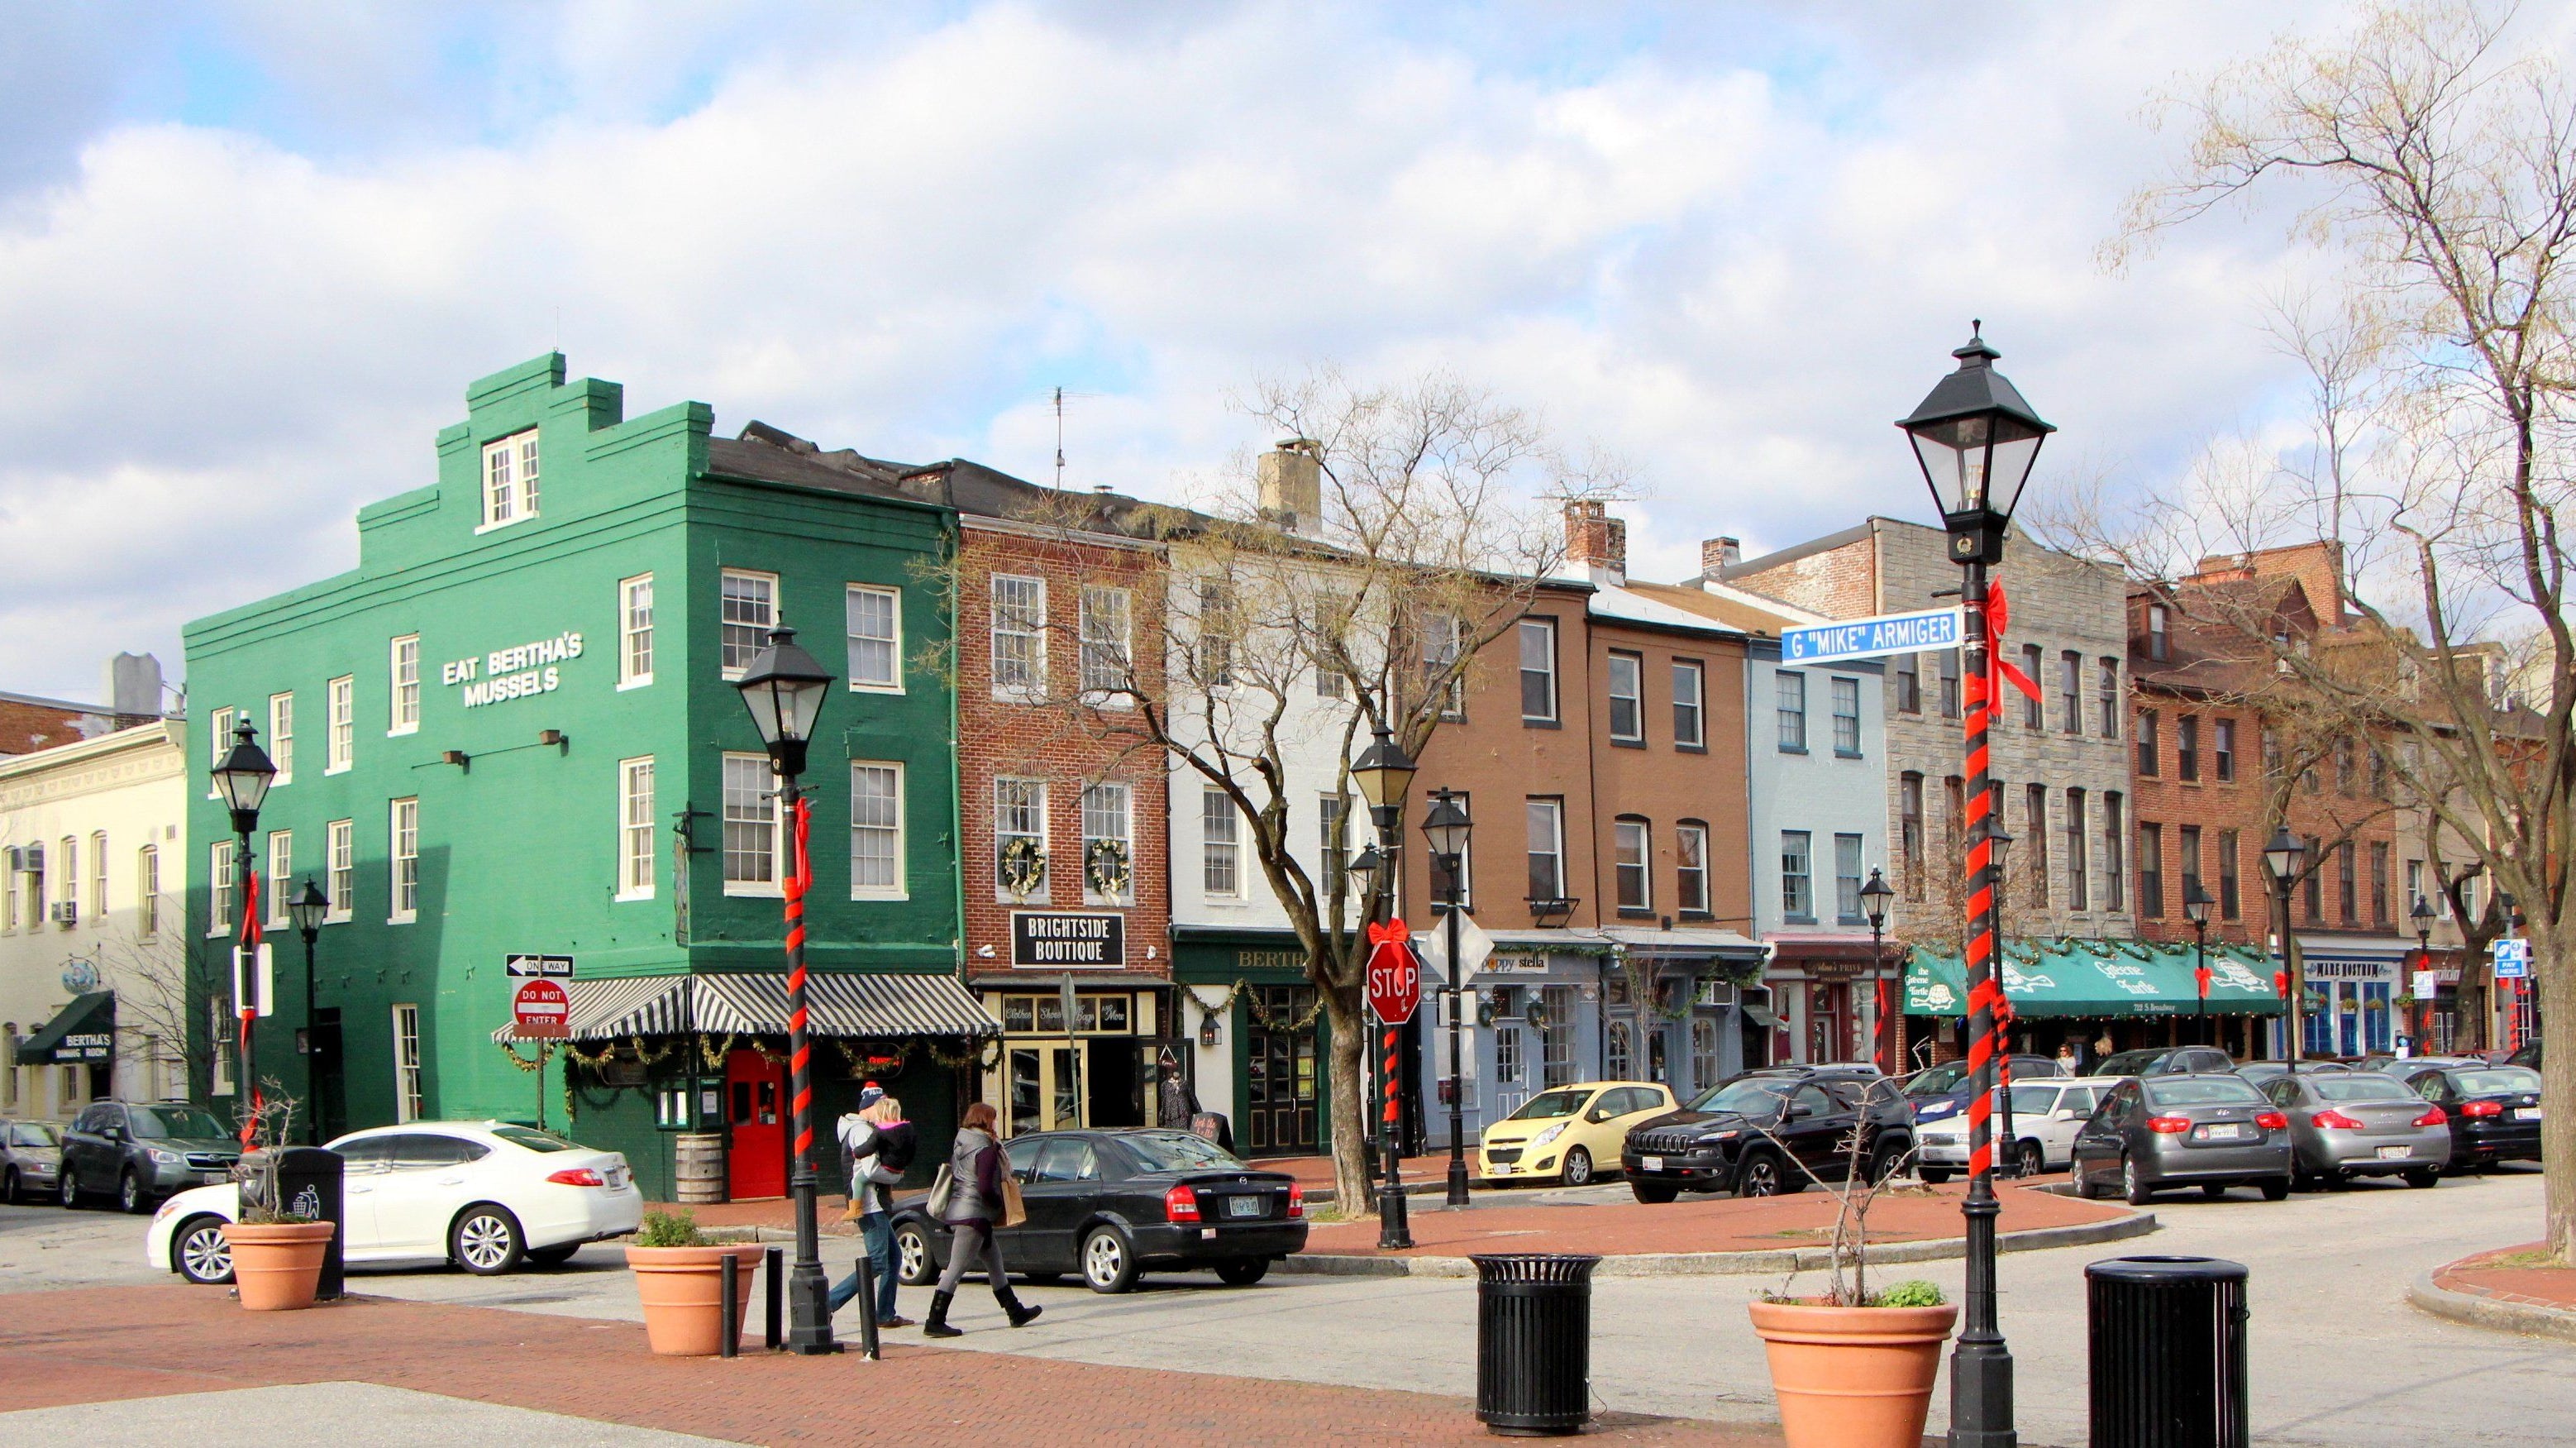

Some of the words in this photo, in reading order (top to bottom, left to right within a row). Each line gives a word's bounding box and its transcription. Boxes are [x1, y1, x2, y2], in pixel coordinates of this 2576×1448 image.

[1791, 633, 1803, 657] G
[1808, 625, 1866, 655] "MIKE"
[1872, 616, 1952, 649] ARMIGER
[443, 657, 479, 686] EAT
[489, 631, 584, 676] BERTHA'S
[464, 667, 560, 708] MUSSELS
[1028, 918, 1109, 938] BRIGHTSIDE
[1035, 940, 1104, 962] BOUTIQUE
[548, 961, 566, 971] WAY
[1238, 952, 1305, 967] BERTH
[1519, 953, 1544, 968] stella
[1918, 967, 1929, 976] the
[2094, 961, 2145, 979] Greene
[2316, 963, 2340, 977] MARE
[2342, 963, 2378, 977] NOSTRUM
[1372, 967, 1416, 998] STOP
[1905, 975, 1929, 986] Greene
[2116, 979, 2159, 994] Turtle
[522, 990, 537, 1000] DO
[541, 991, 561, 1000] NOT
[1908, 986, 1929, 996] Turtle
[1005, 1006, 1032, 1020] Clothes
[2150, 1003, 2176, 1012] Broadway
[526, 1016, 558, 1025] ENTER
[1104, 1009, 1125, 1021] More
[66, 1034, 111, 1047] BERTHA'S
[85, 1047, 107, 1057] ROOM
